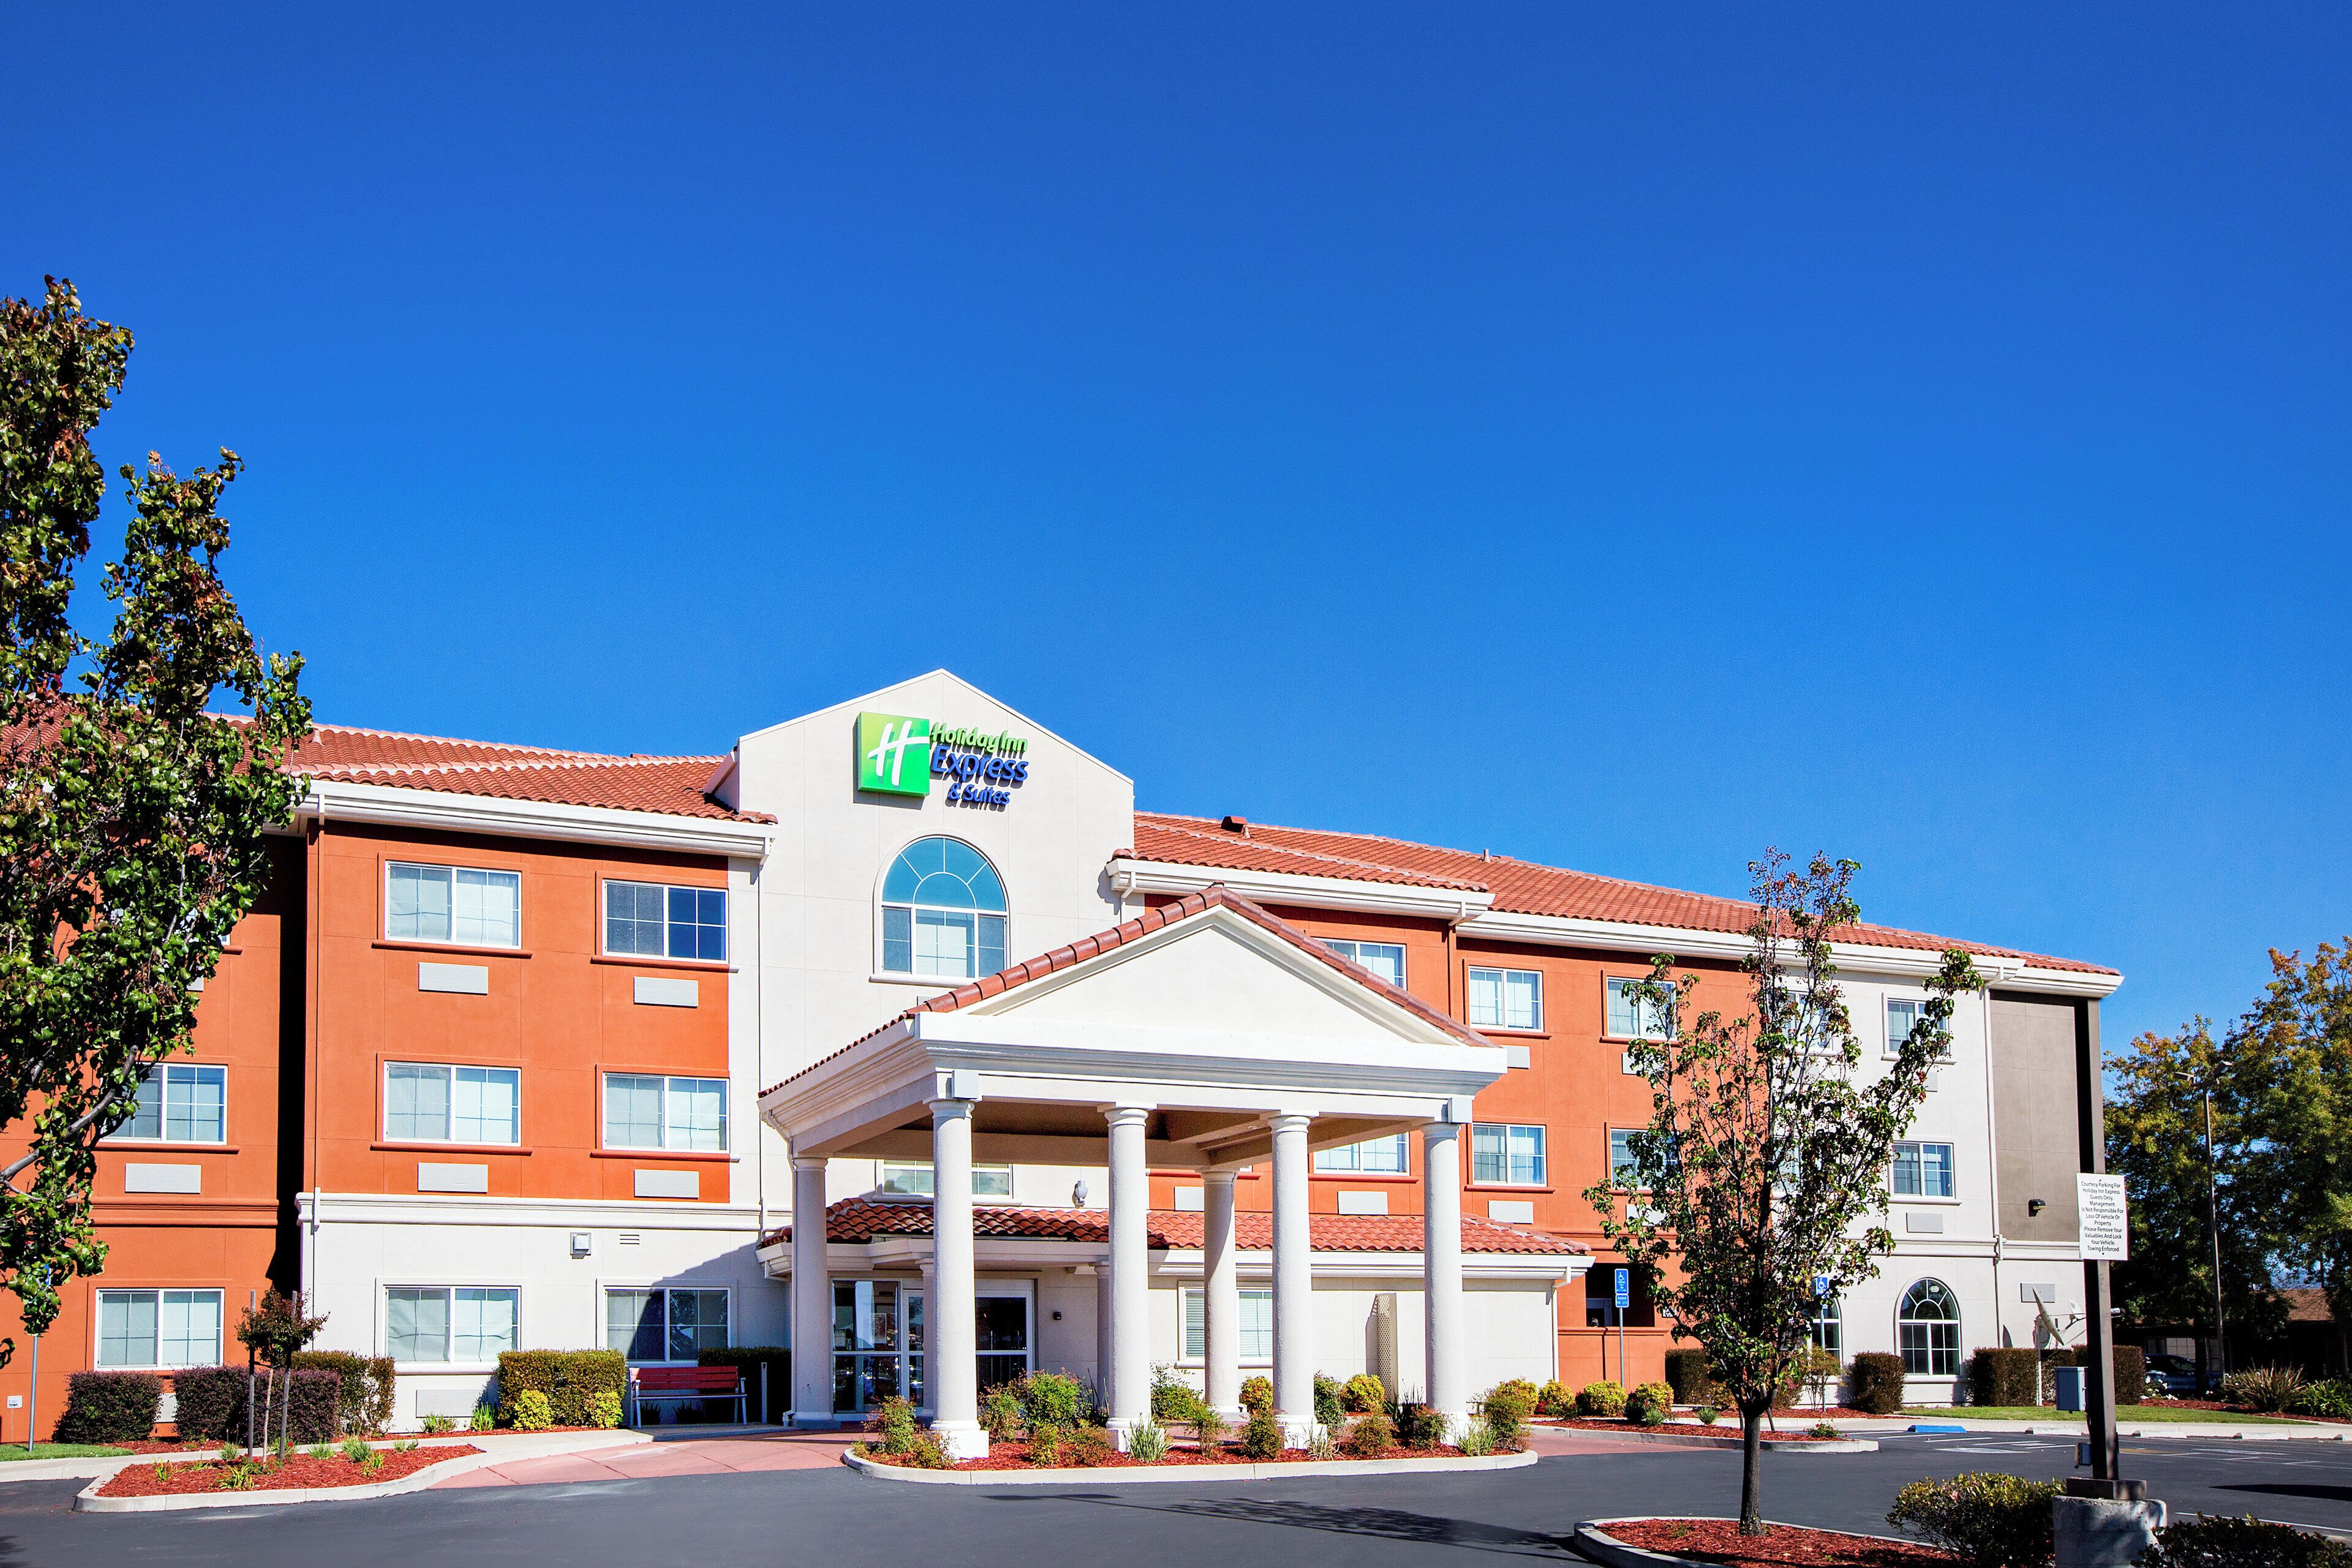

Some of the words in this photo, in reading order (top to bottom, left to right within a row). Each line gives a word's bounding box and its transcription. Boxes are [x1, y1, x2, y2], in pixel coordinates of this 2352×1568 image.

[931, 722, 1000, 752] Holiday
[1000, 730, 1028, 753] Inn
[931, 745, 1029, 783] Express
[948, 783, 960, 800] &
[962, 784, 1011, 805] Suites
